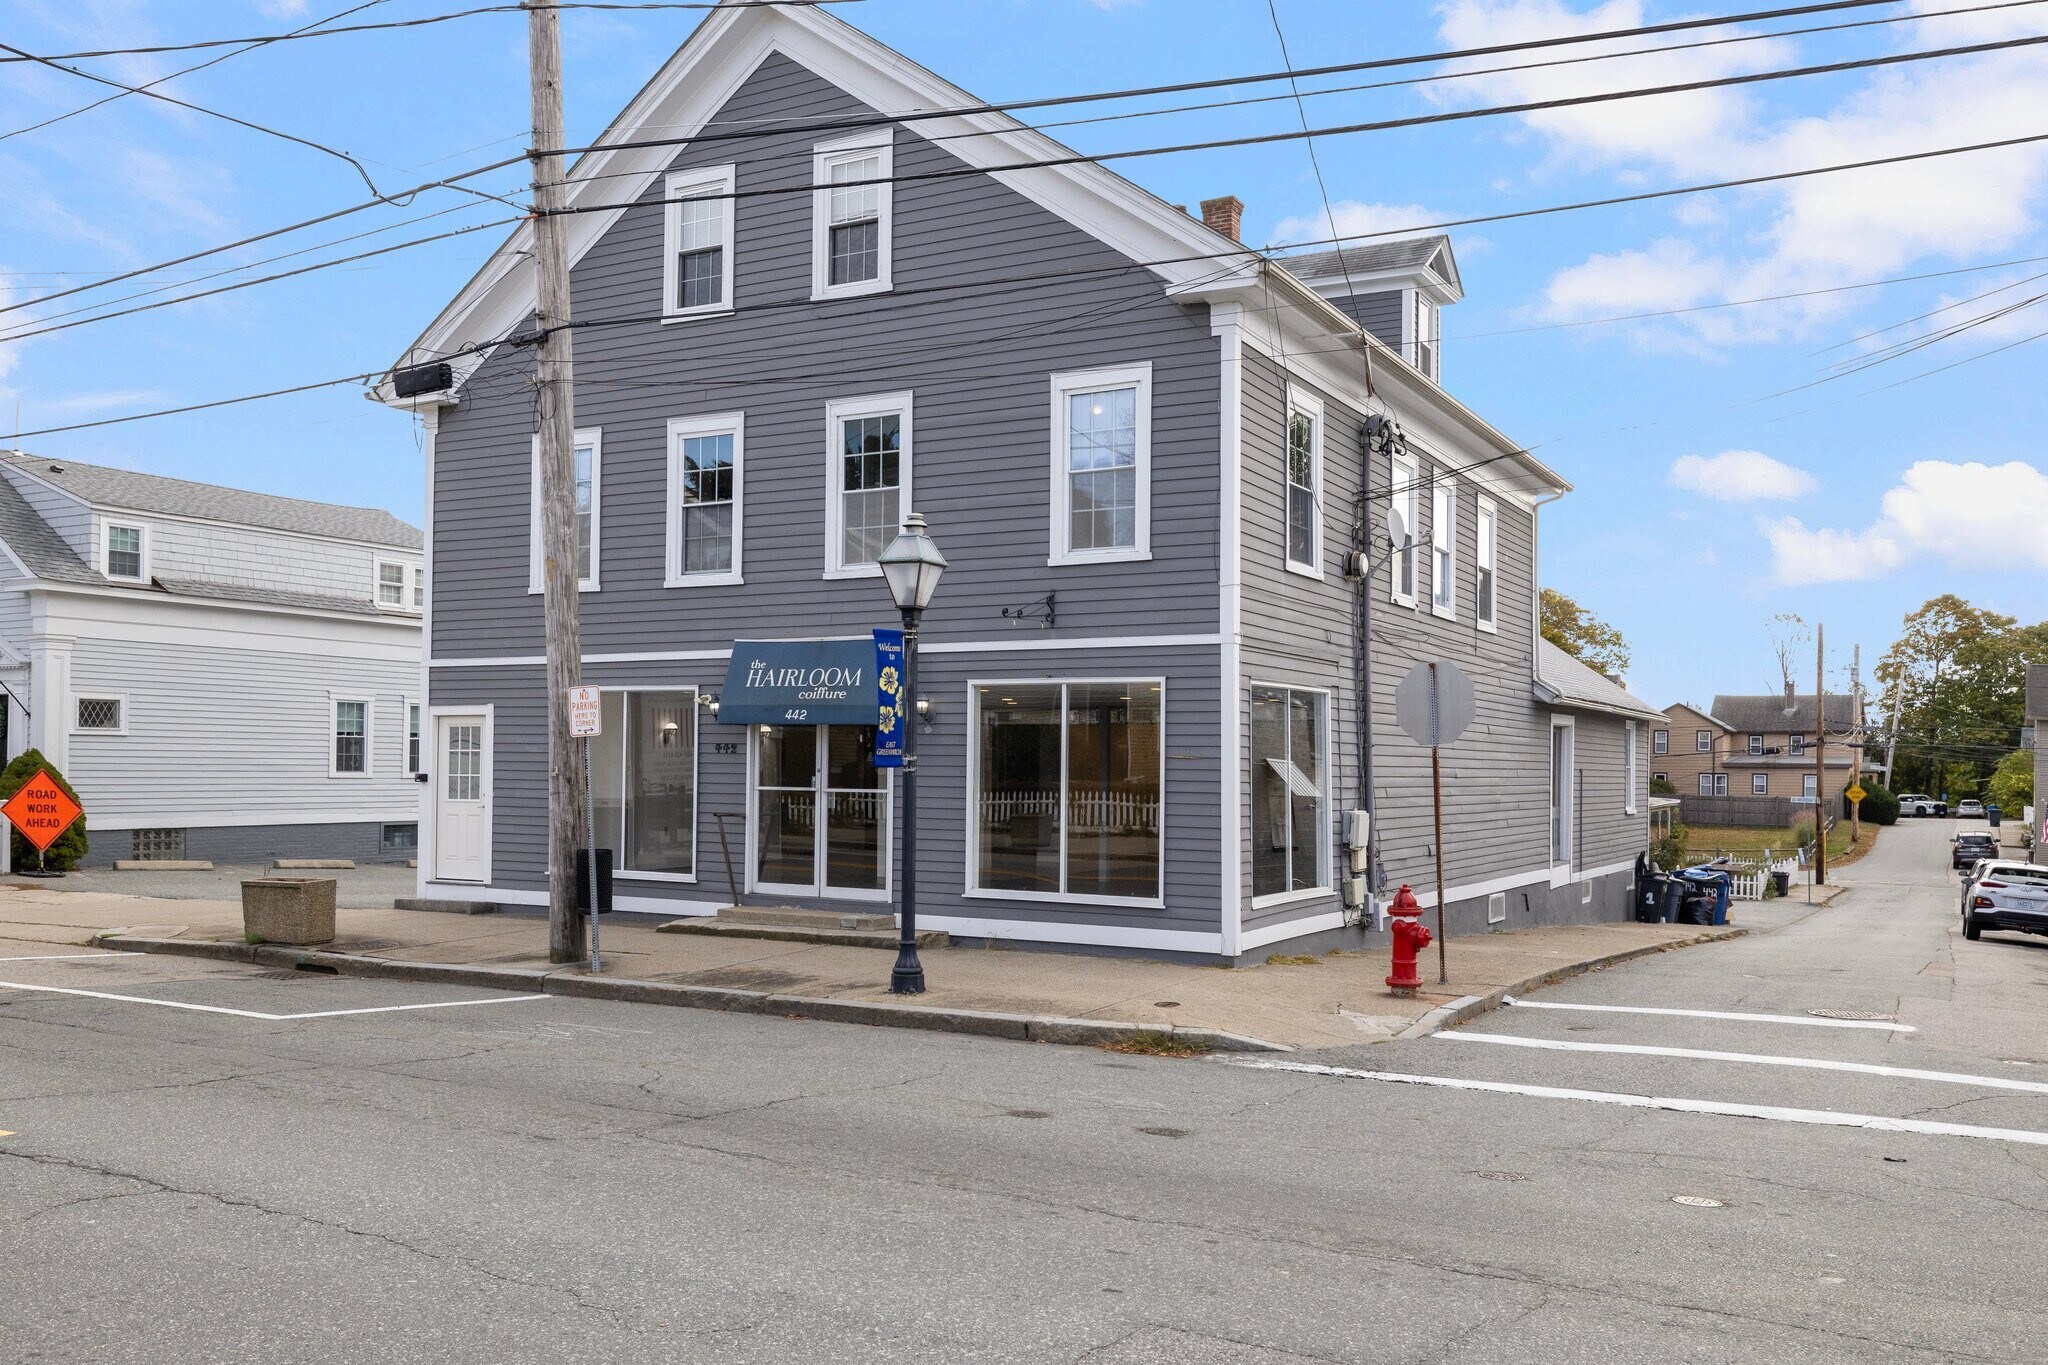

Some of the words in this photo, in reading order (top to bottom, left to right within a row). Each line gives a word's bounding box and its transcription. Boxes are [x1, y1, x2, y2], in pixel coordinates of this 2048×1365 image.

[750, 659, 767, 669] the
[745, 667, 862, 687] HAIRLOOM
[579, 691, 590, 700] NO
[798, 687, 847, 699] coiffure
[572, 701, 598, 711] PARKING
[784, 709, 808, 720] 442
[575, 719, 595, 727] CORNER
[715, 743, 737, 754] 442
[27, 789, 57, 799] ROAD
[27, 804, 57, 813] WORK
[25, 818, 60, 828] AHEAD
[1645, 892, 1655, 904] 1
